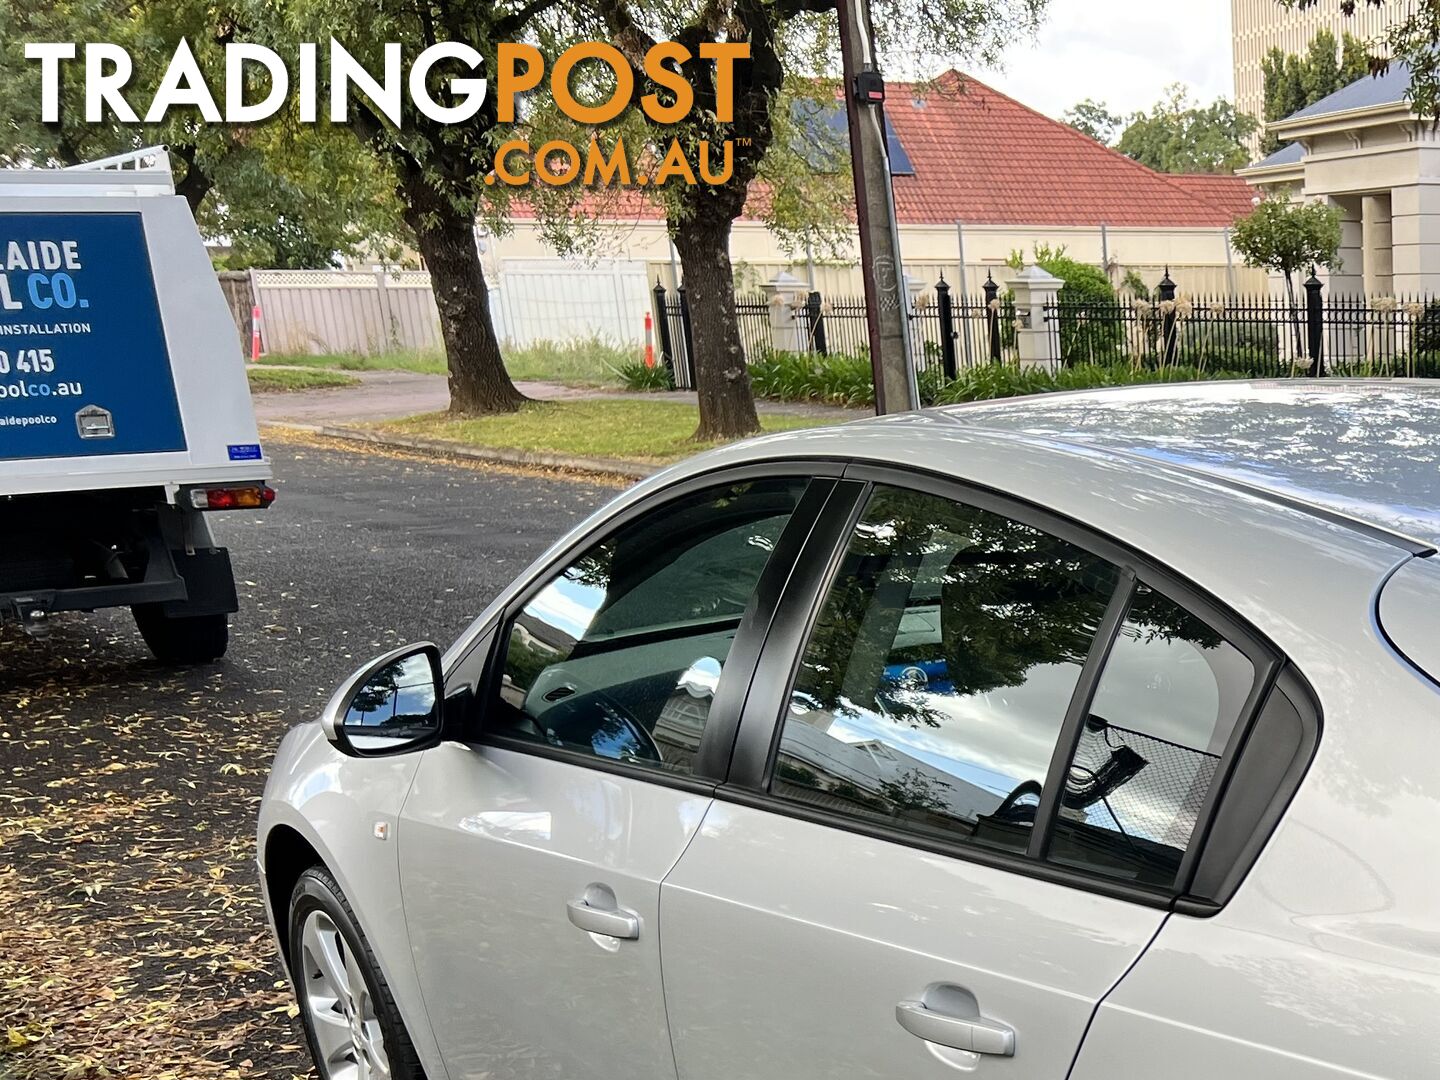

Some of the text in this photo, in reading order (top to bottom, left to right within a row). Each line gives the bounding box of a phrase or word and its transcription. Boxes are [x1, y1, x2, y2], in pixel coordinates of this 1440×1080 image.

[0, 241, 82, 270] AIDE
[27, 272, 89, 309] CO.
[0, 323, 91, 335] INSTALLATION
[16, 348, 55, 373] 415
